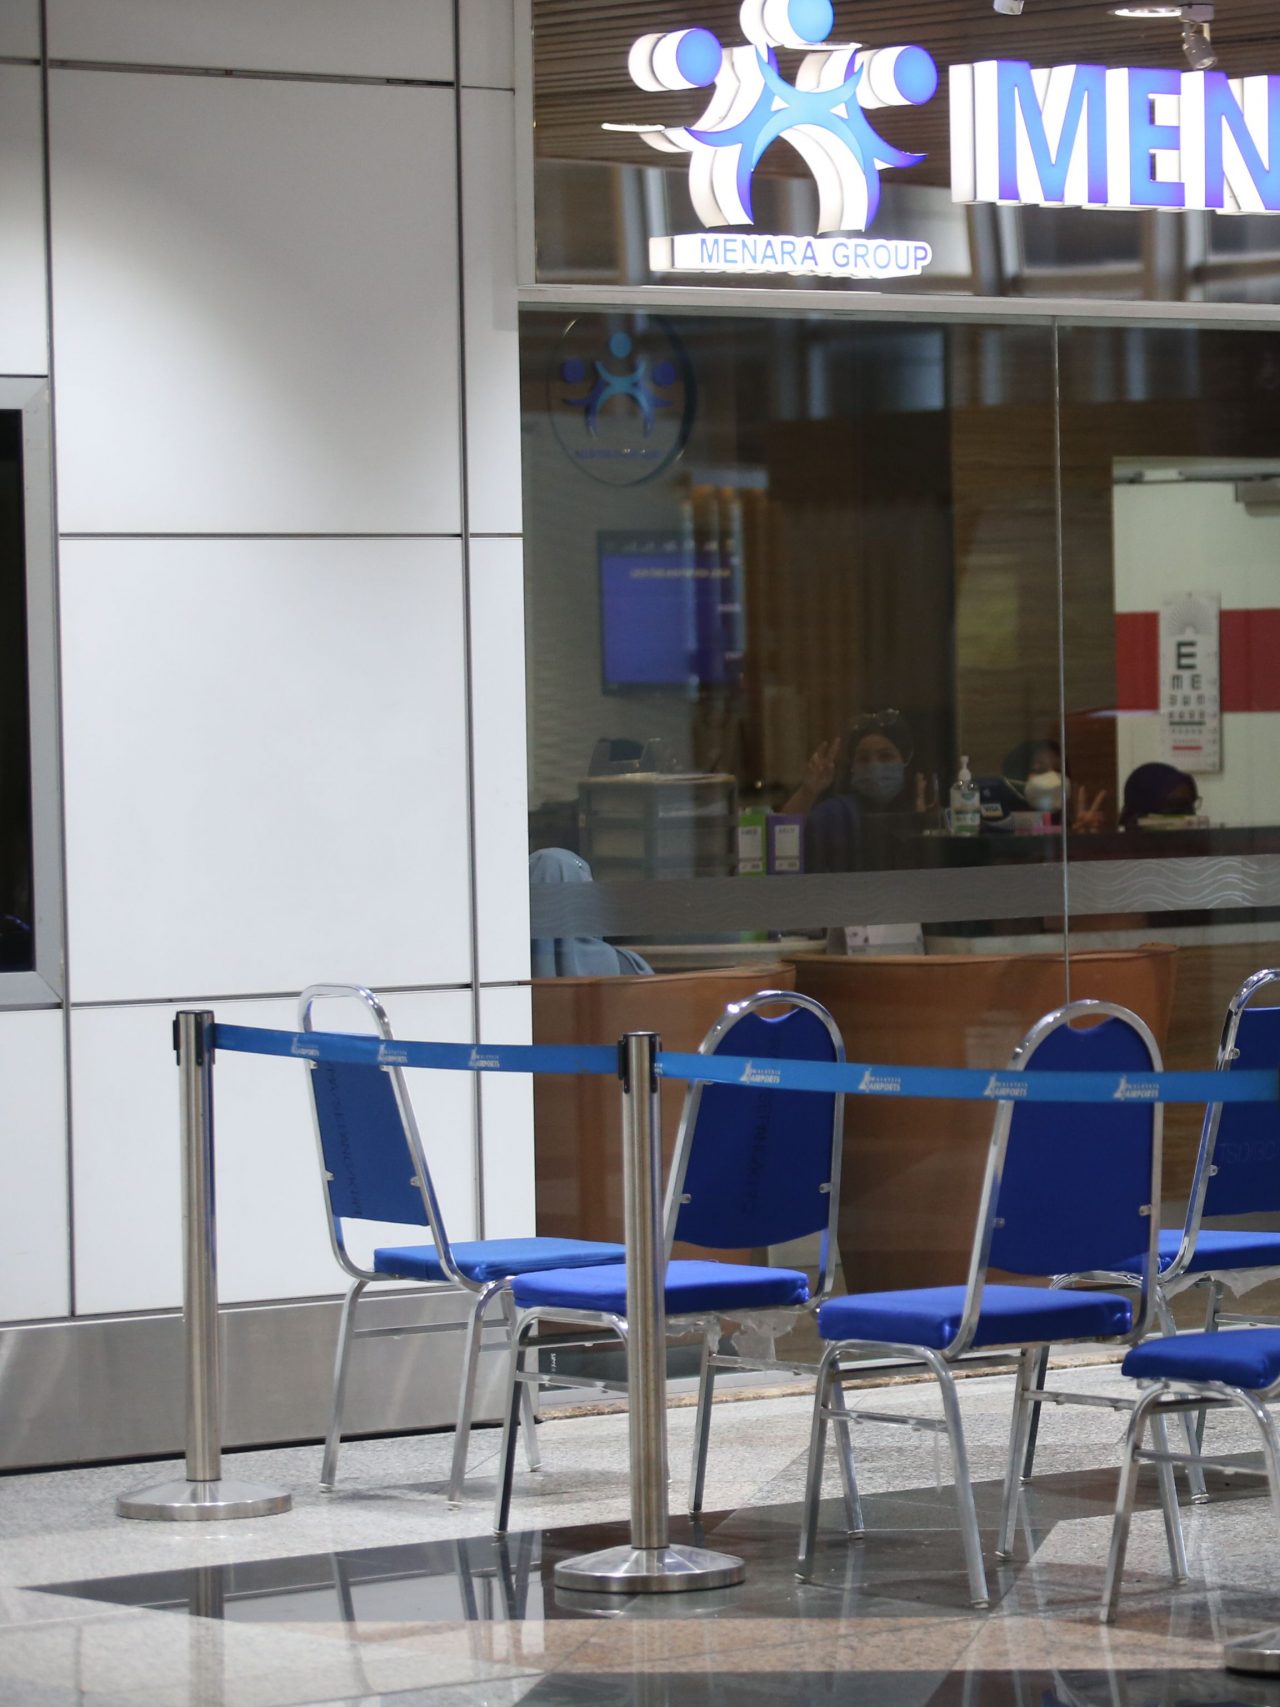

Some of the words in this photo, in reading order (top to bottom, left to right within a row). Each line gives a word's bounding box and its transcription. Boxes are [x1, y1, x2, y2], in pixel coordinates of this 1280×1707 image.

[699, 237, 819, 268] MENARA
[832, 241, 932, 271] GROUP
[750, 1073, 780, 1084] AIRPORTS
[869, 1082, 901, 1092] AIRPORTS
[993, 1087, 1028, 1097] AIRPORTS
[1125, 1088, 1159, 1098] AIRPORTS
